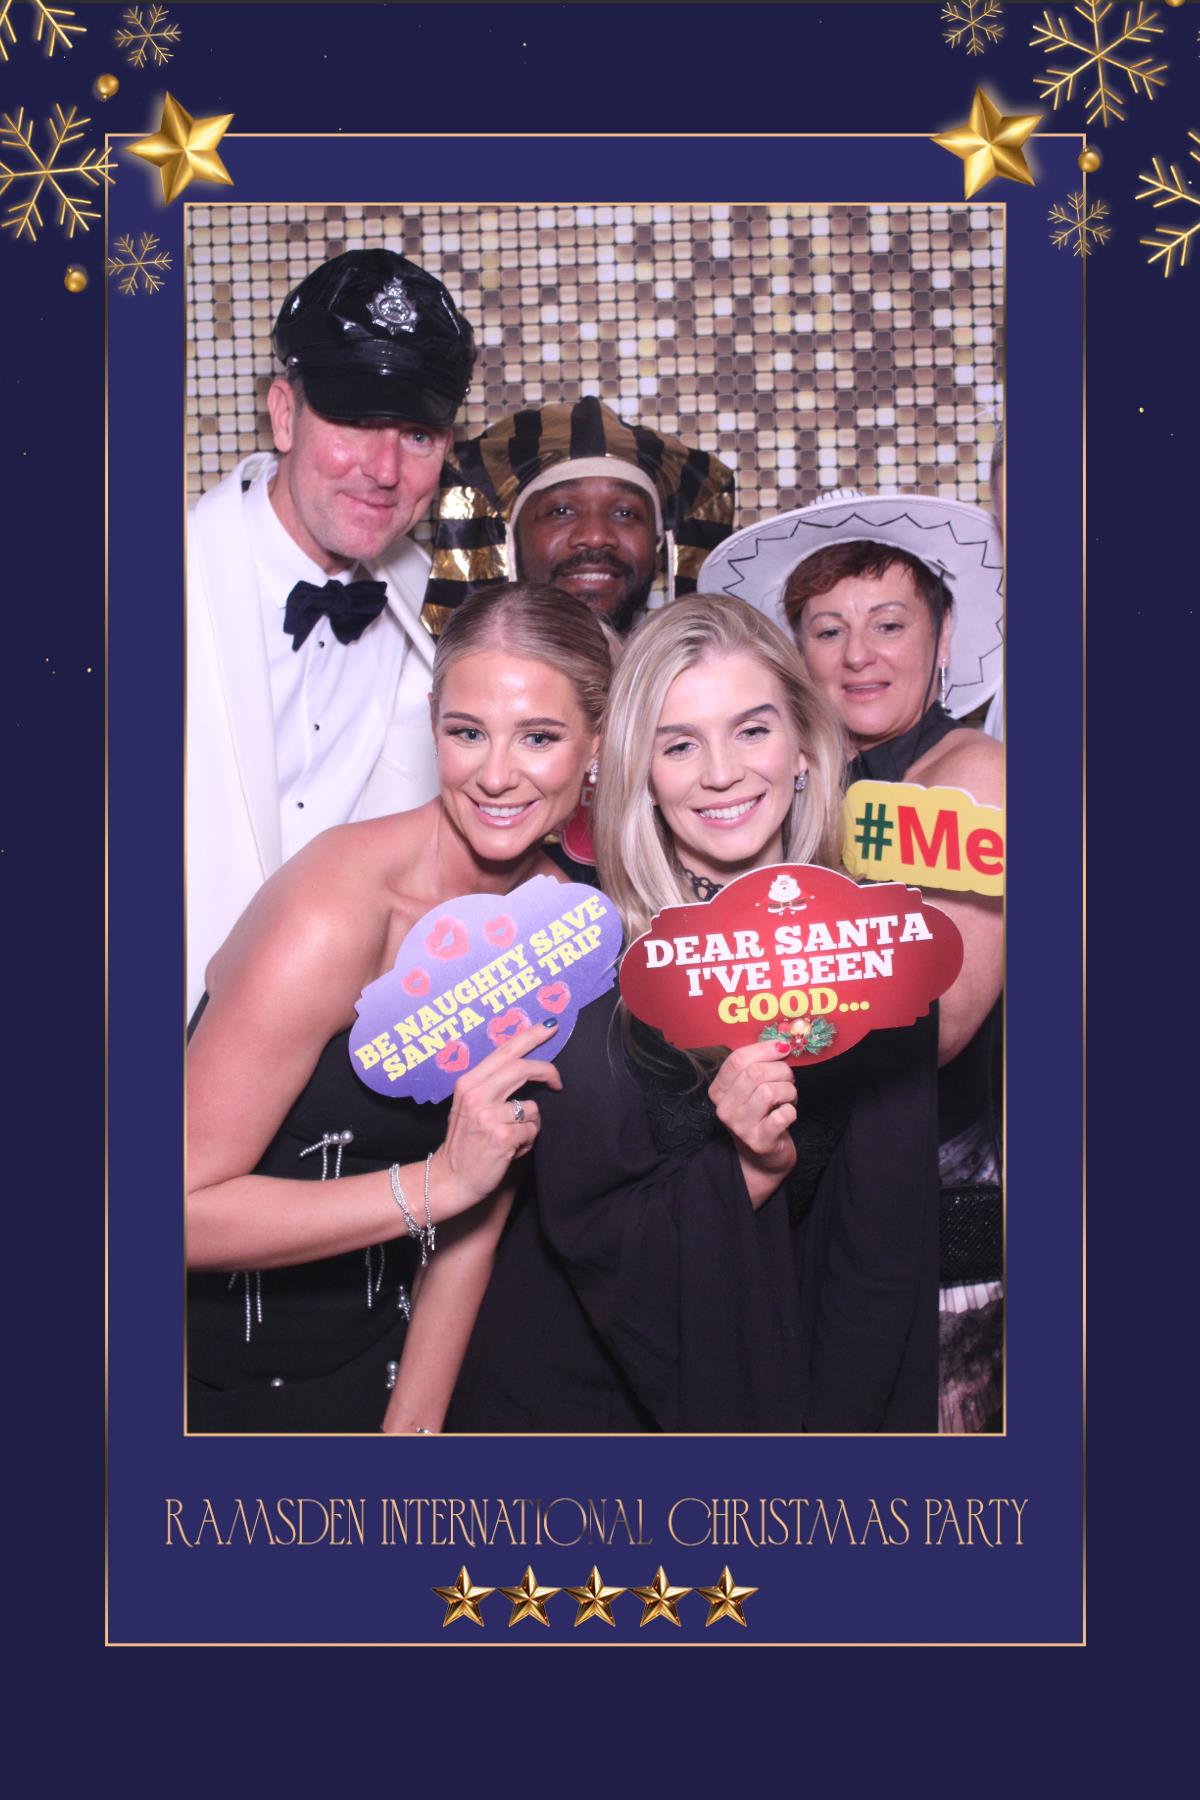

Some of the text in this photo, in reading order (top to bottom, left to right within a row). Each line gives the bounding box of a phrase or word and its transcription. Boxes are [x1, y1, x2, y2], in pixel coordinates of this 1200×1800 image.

[643, 912, 933, 968] DEAR SANTA
[354, 894, 607, 1070] BE NAUGHTY SAVE
[686, 948, 894, 997] I'VE BEEN
[382, 925, 602, 1082] SANTA THE TRIP
[718, 987, 870, 1025] GOOD...
